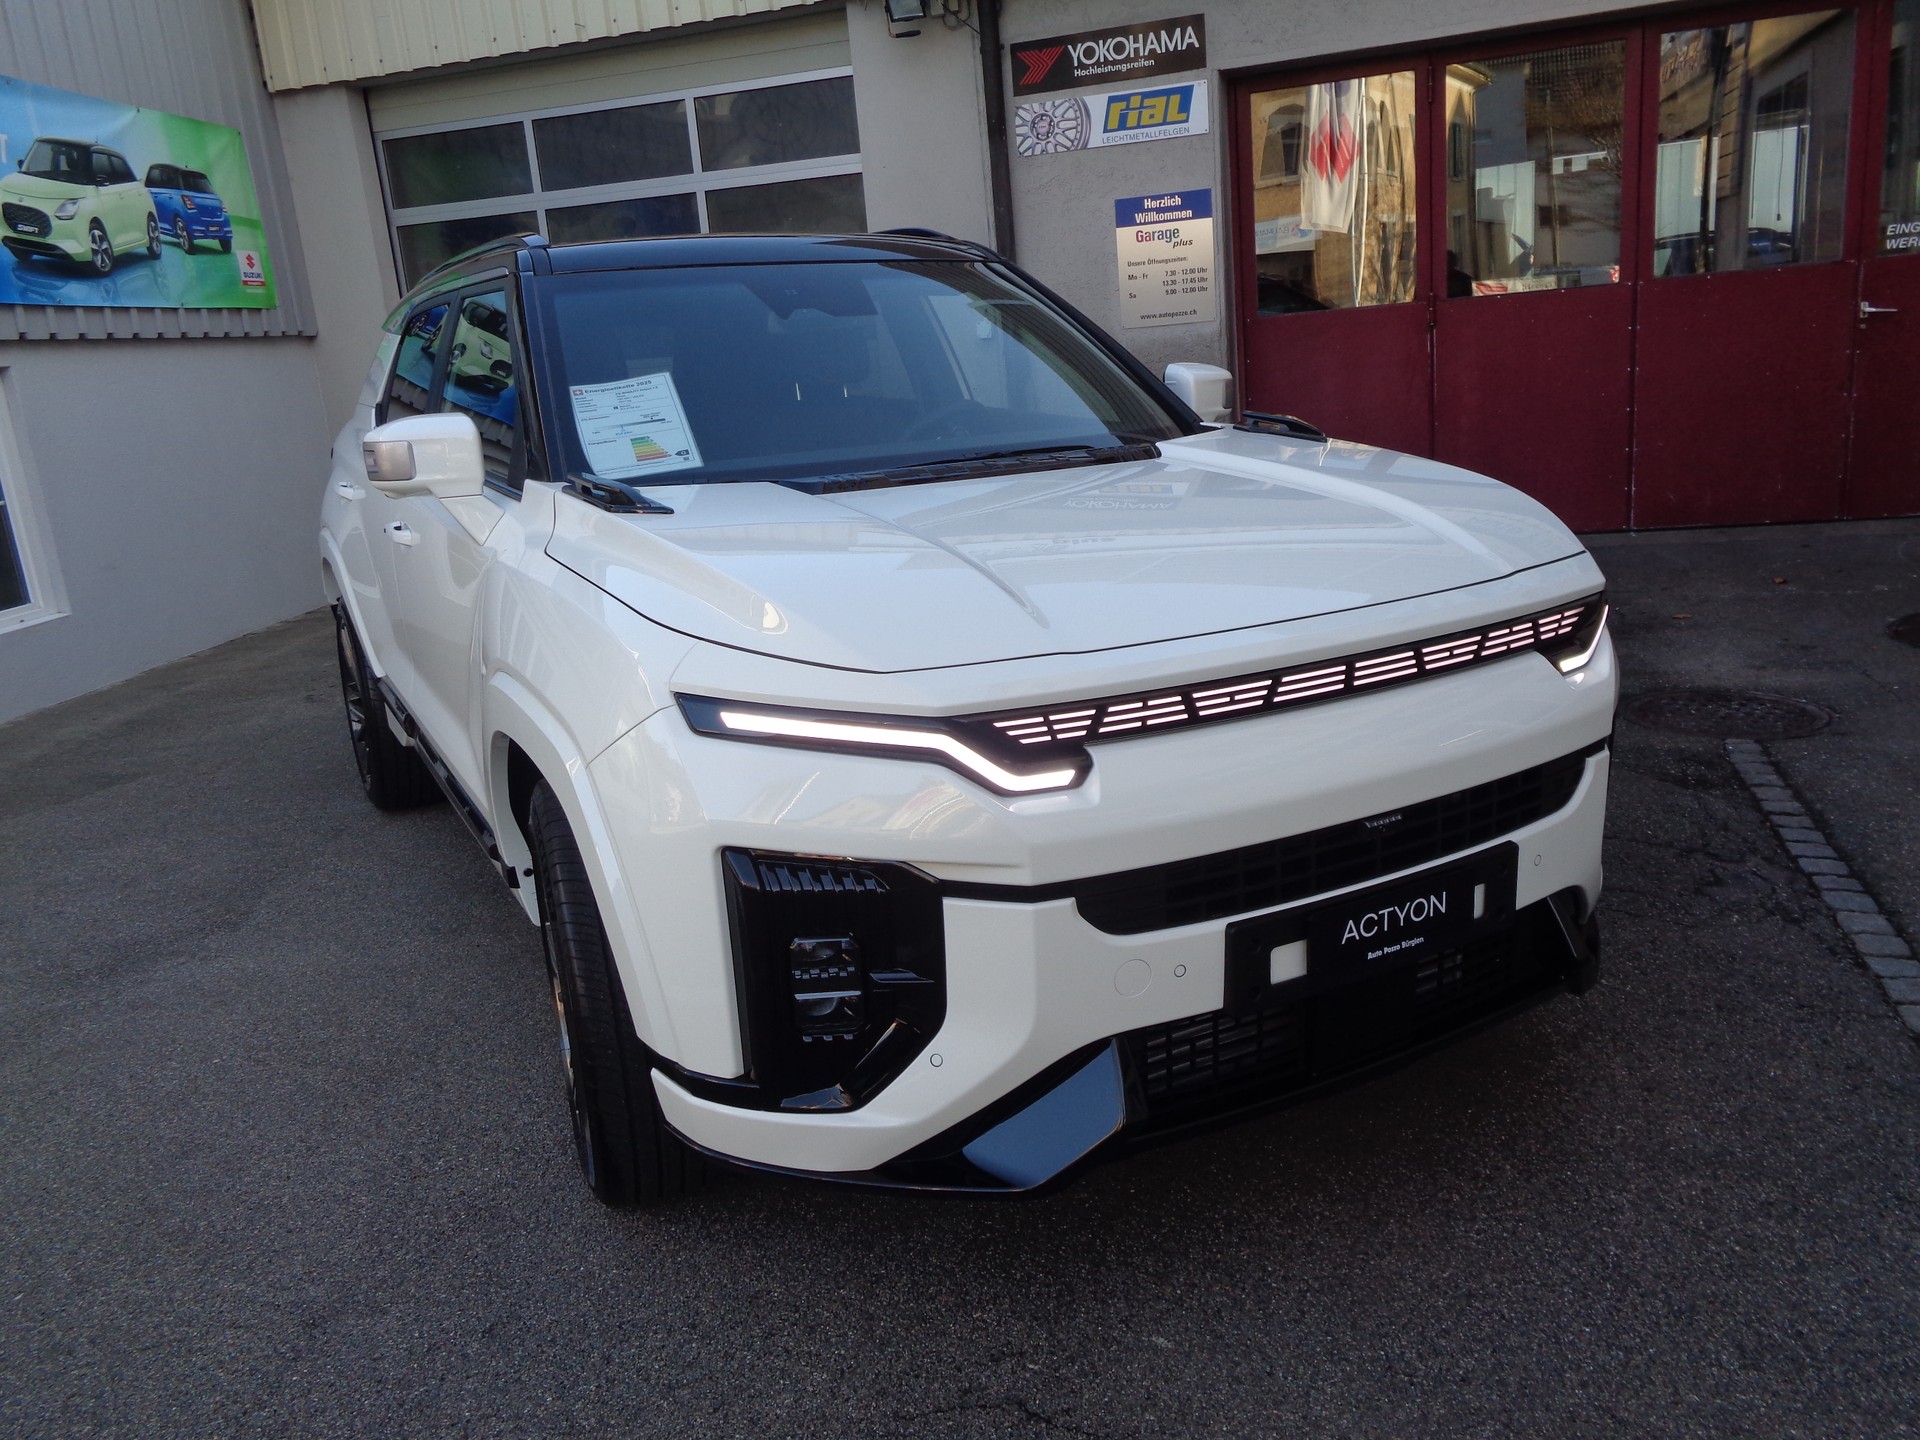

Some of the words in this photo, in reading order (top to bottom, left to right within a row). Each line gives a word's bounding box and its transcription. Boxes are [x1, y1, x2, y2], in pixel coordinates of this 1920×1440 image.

[1067, 26, 1200, 67] YOKOHAMA
[1074, 59, 1155, 77] Hochleistungsreifen
[1102, 126, 1190, 145] LEICHTMETALLFELGEN
[1144, 195, 1182, 209] Herzlich
[1135, 210, 1193, 223] Willkommen
[1135, 228, 1180, 243] Garage
[1172, 239, 1194, 248] plus
[1886, 236, 1920, 250] WER
[1165, 269, 1177, 277] 7.30
[1165, 288, 1177, 296] 9.00
[1182, 286, 1197, 294] 12.00
[1341, 891, 1446, 945] ACTYON
[1367, 950, 1383, 960] Auto
